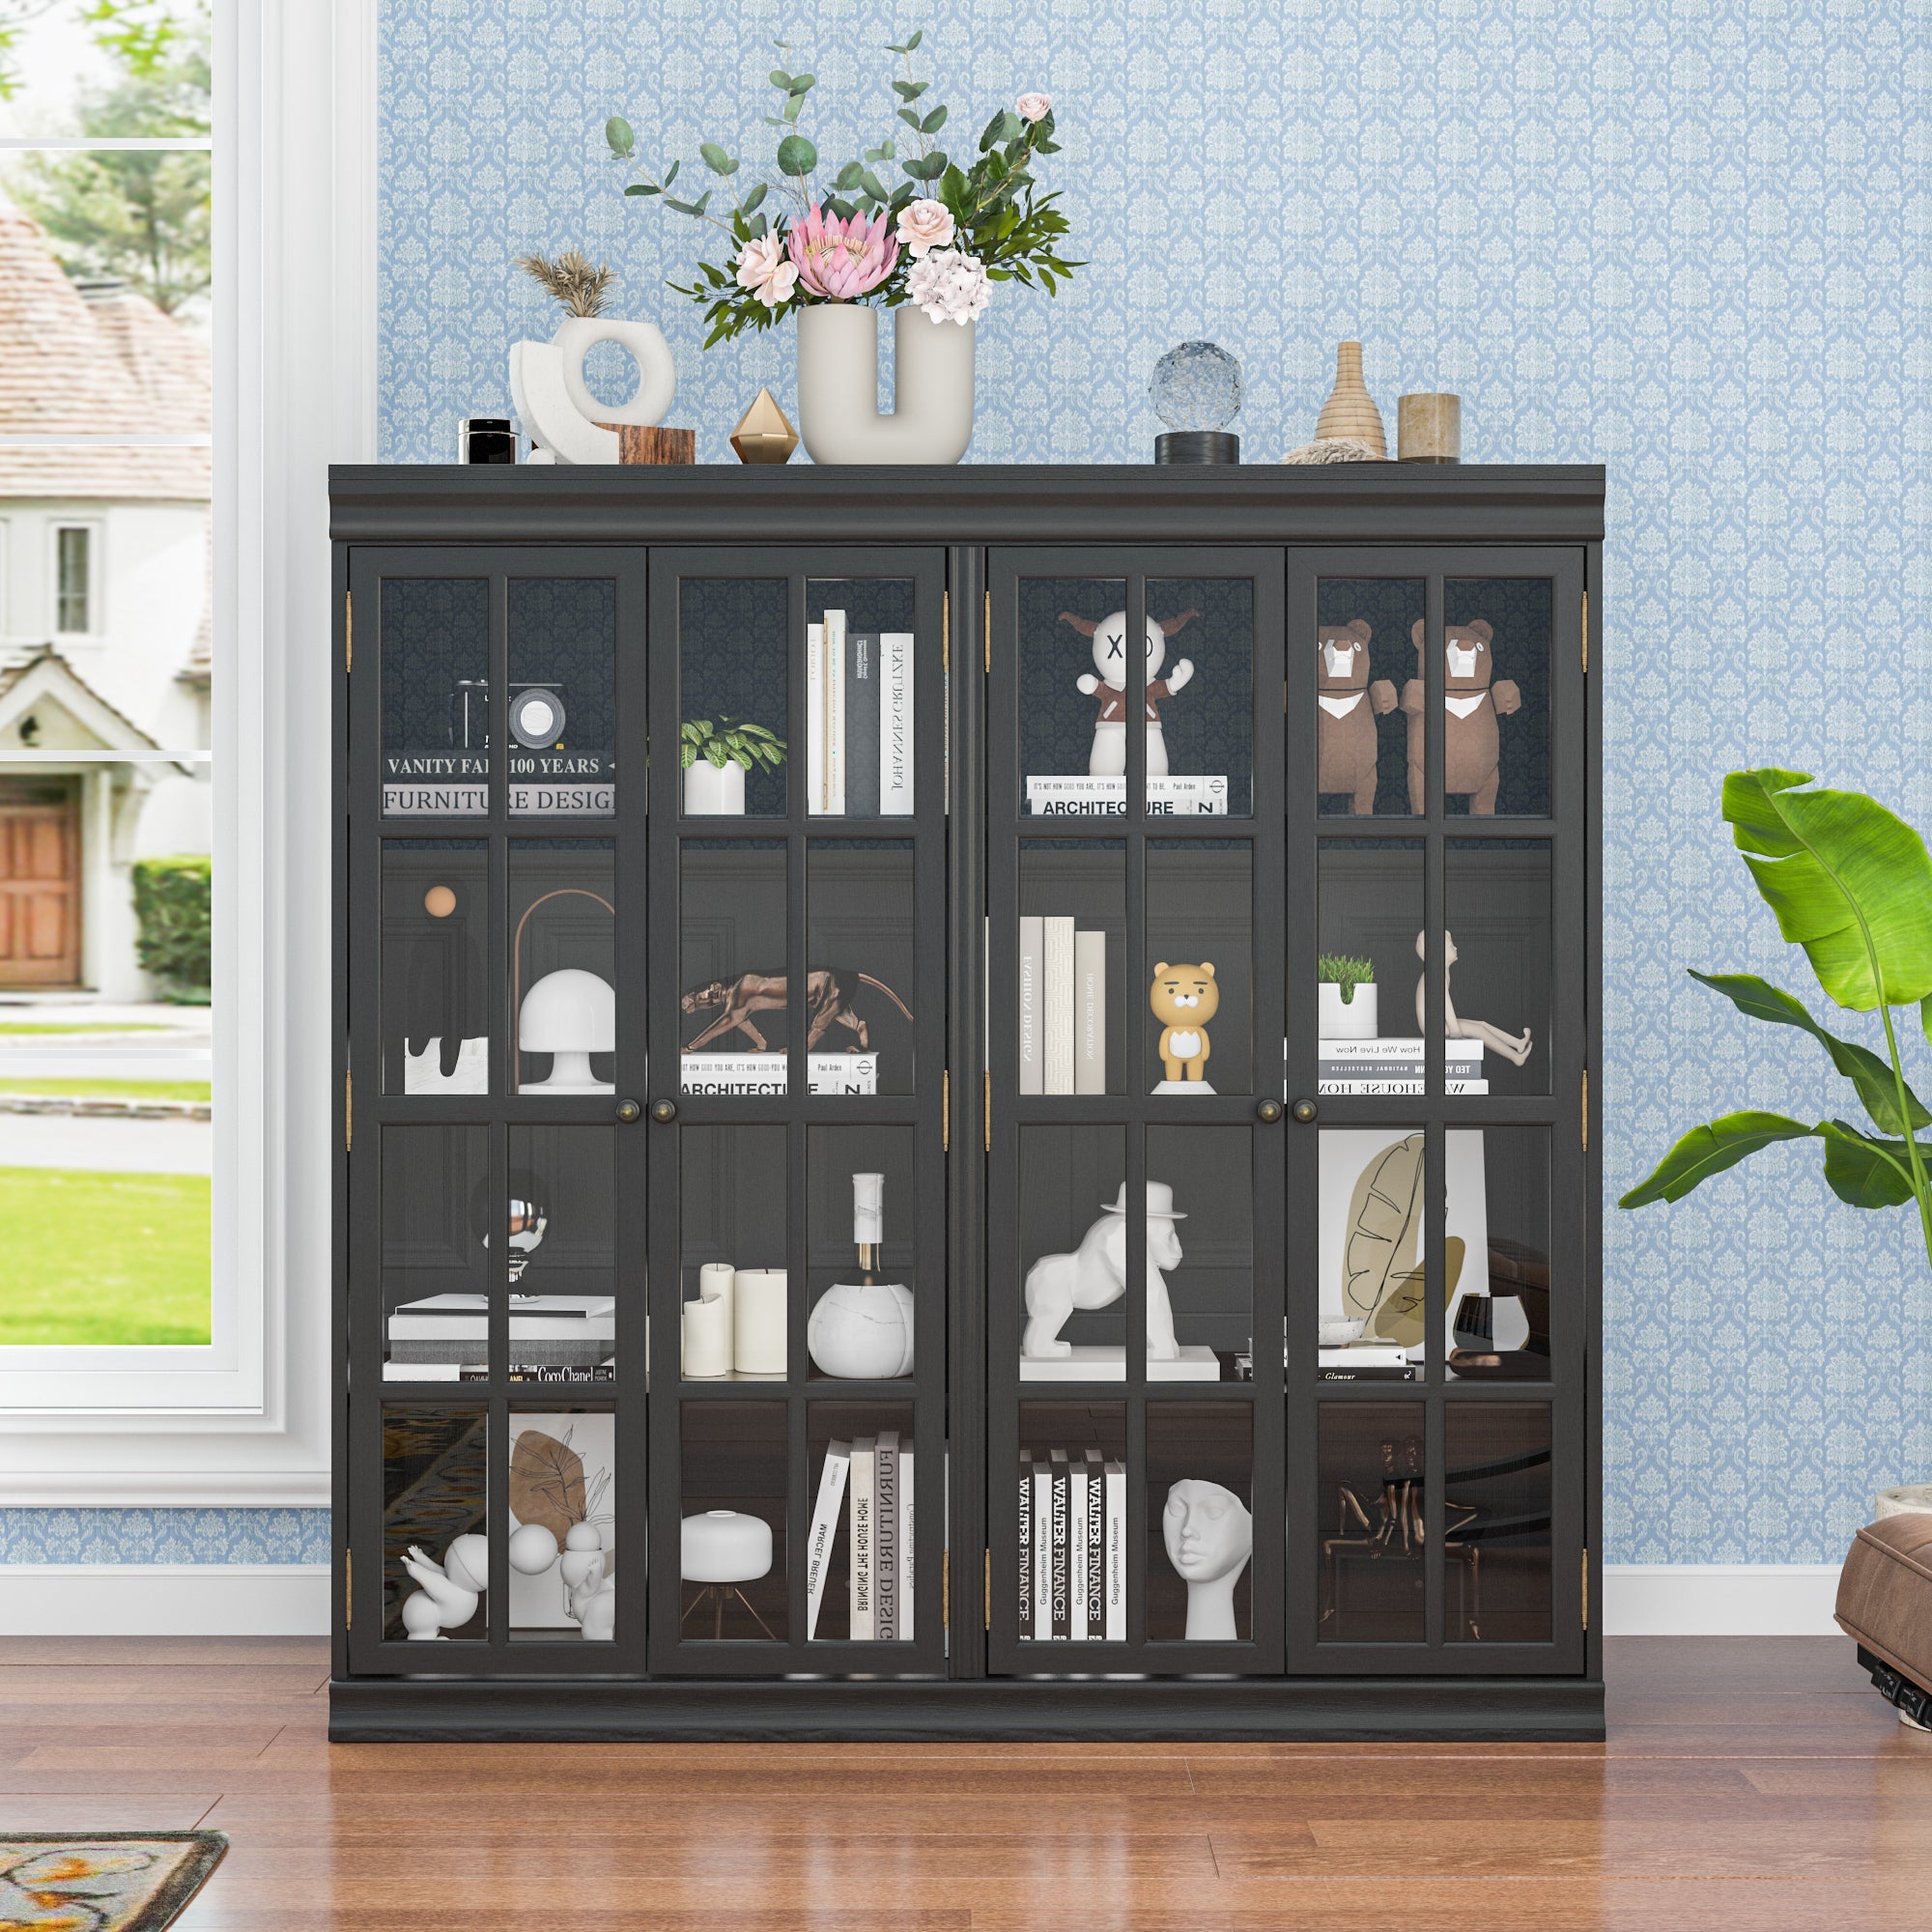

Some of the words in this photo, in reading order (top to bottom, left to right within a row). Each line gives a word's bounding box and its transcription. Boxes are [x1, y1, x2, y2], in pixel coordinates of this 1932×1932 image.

[387, 758, 456, 774] VANITY
[462, 758, 489, 774] FAI
[510, 758, 535, 774] 100
[540, 758, 600, 774] YEARS
[537, 791, 615, 810] DESIG
[1324, 1372, 1356, 1380] Glamour
[1053, 1477, 1066, 1546] WALTER
[1089, 1477, 1101, 1546] WALTER
[1039, 1553, 1049, 1605] Guggenheim
[1053, 1547, 1066, 1621] FINANCE
[1076, 1553, 1086, 1605] Guggenheim
[1089, 1547, 1101, 1621] FINANCE
[1112, 1553, 1121, 1605] Guggenheim
